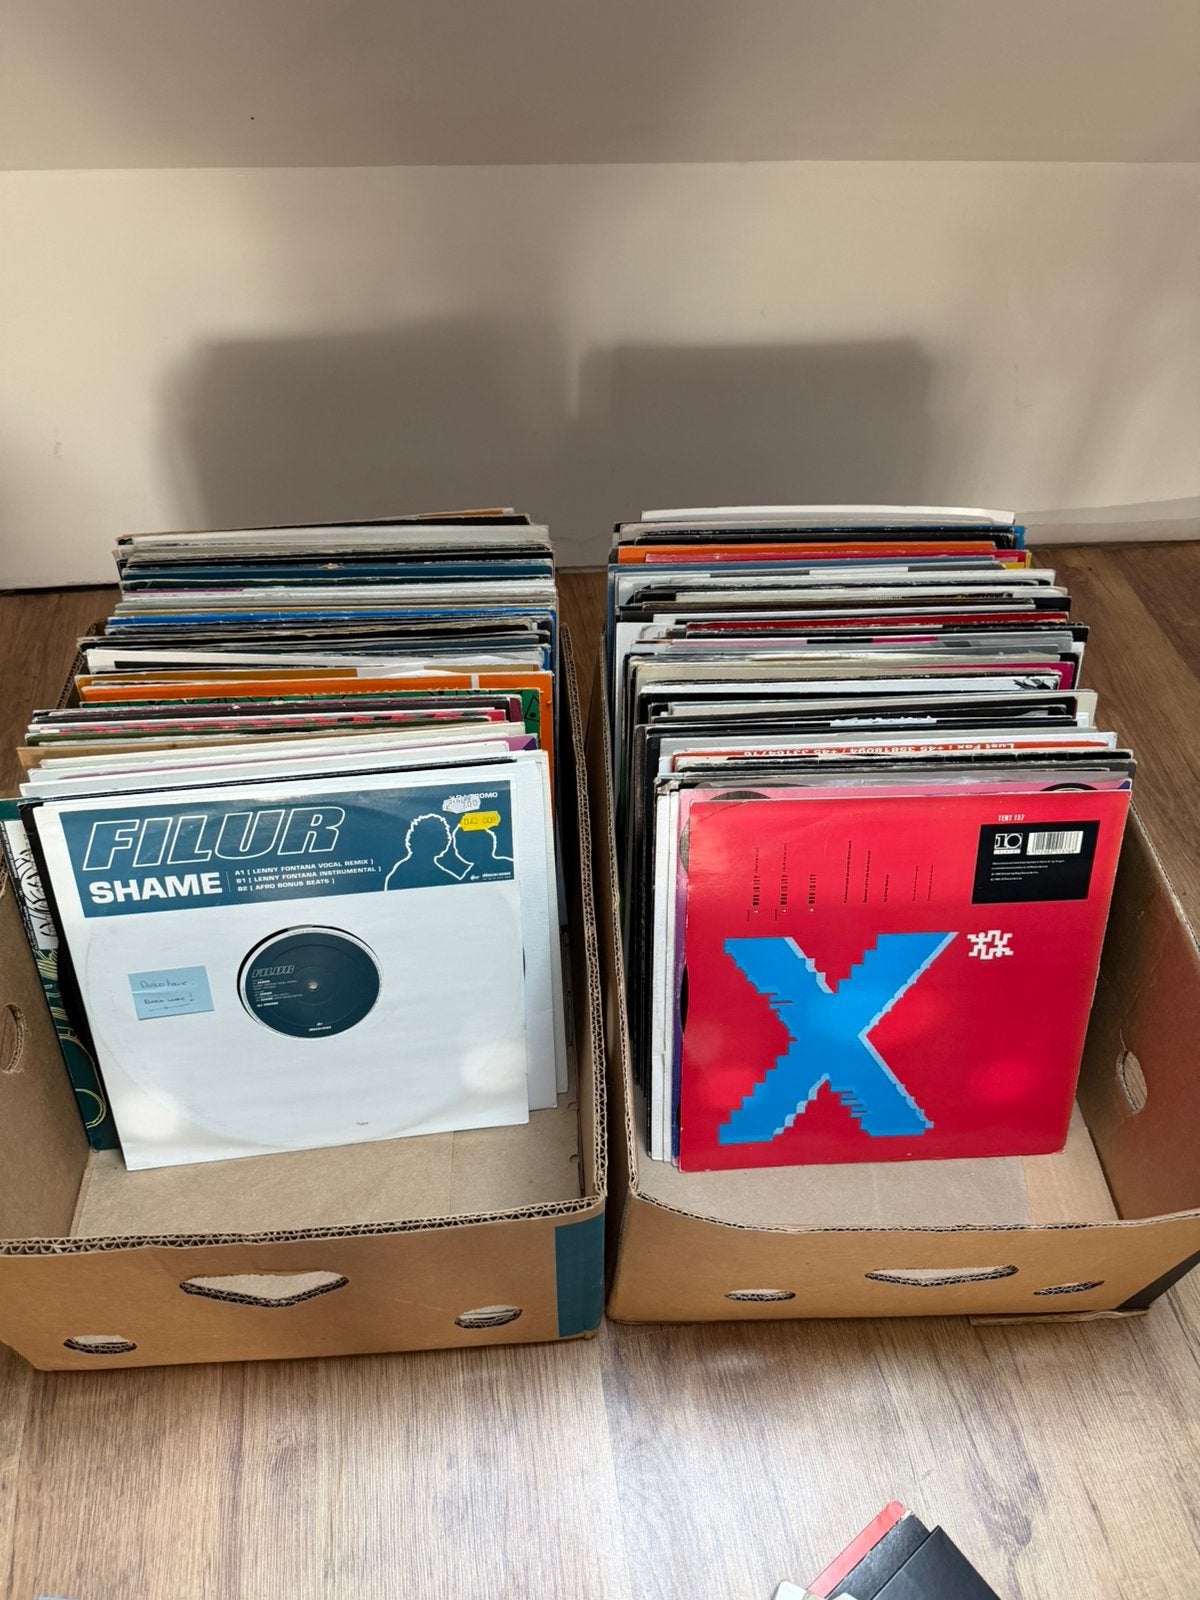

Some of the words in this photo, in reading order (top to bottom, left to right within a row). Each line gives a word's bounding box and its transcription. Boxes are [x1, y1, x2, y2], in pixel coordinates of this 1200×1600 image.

[82, 806, 346, 872] FILUR
[252, 867, 278, 875] LENNY
[280, 864, 316, 872] FONTANA
[344, 859, 368, 867] REMIX
[254, 875, 279, 883] LENNY
[282, 872, 317, 880] FONTANA
[320, 867, 376, 876] INSTRUMENTAL
[89, 872, 223, 904] SHAME
